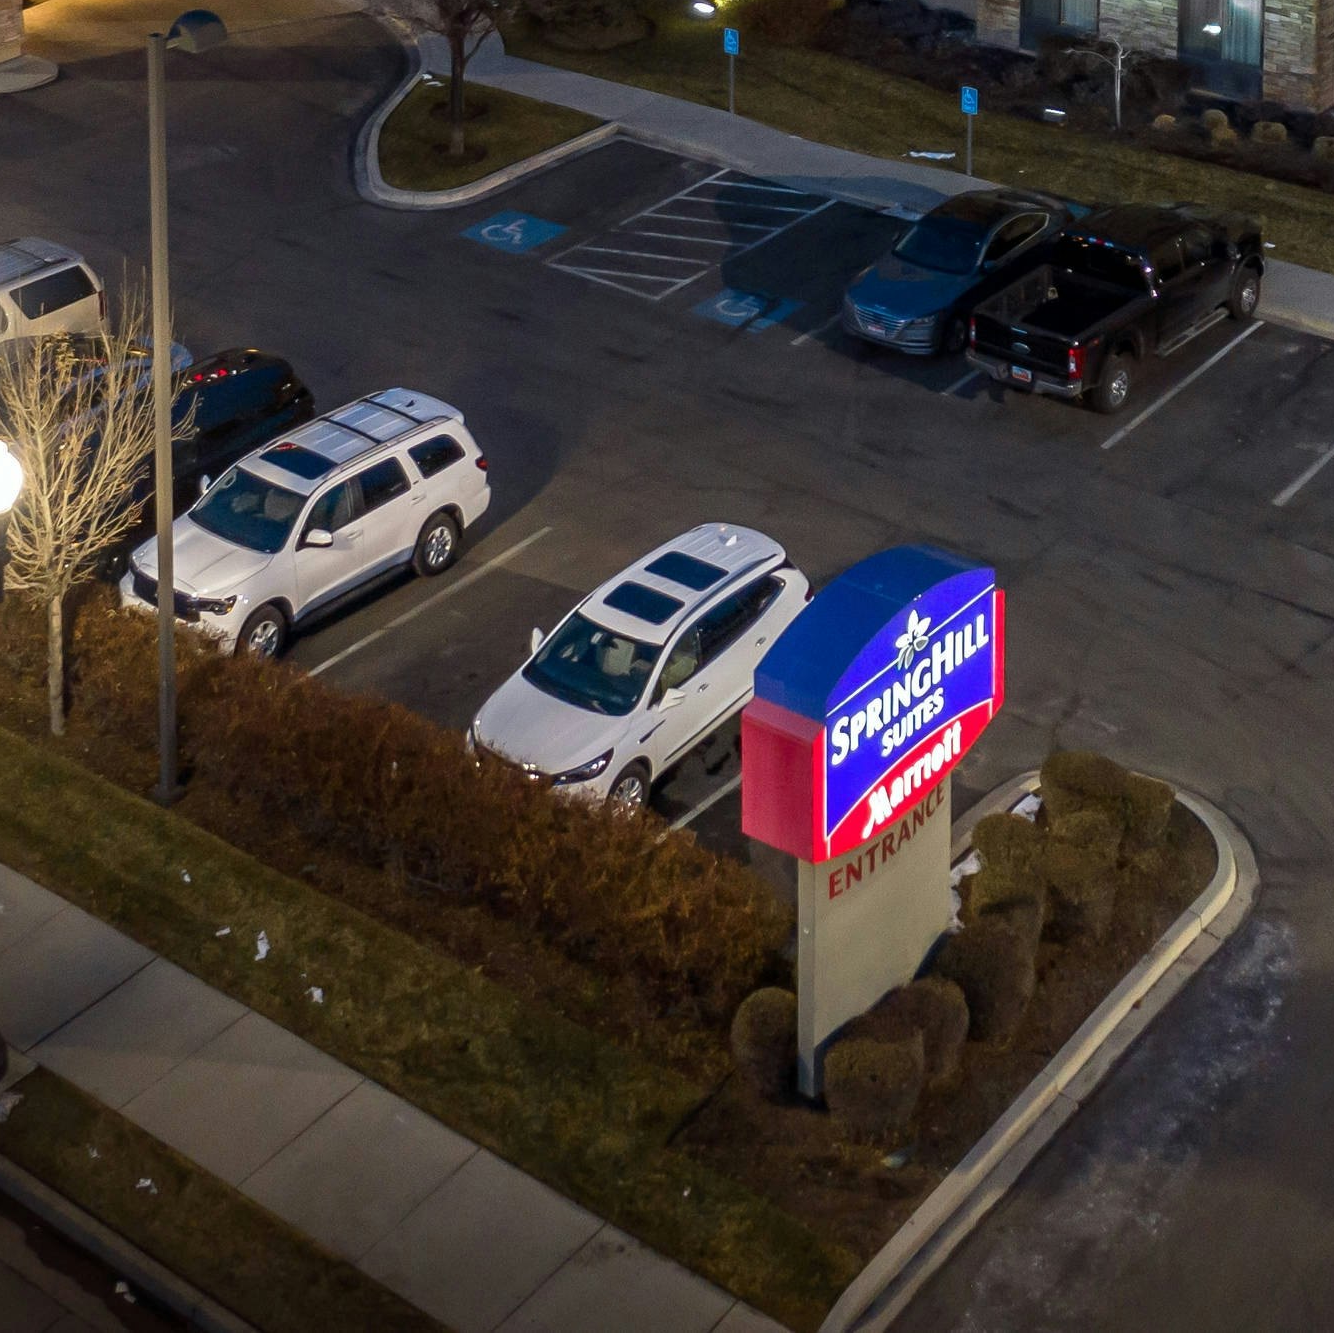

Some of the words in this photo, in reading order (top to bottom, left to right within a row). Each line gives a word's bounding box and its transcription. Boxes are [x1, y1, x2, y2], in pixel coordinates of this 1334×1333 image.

[861, 720, 962, 839] Marriott
[881, 687, 945, 758] SUITES
[828, 777, 945, 899] ENTRANCE
